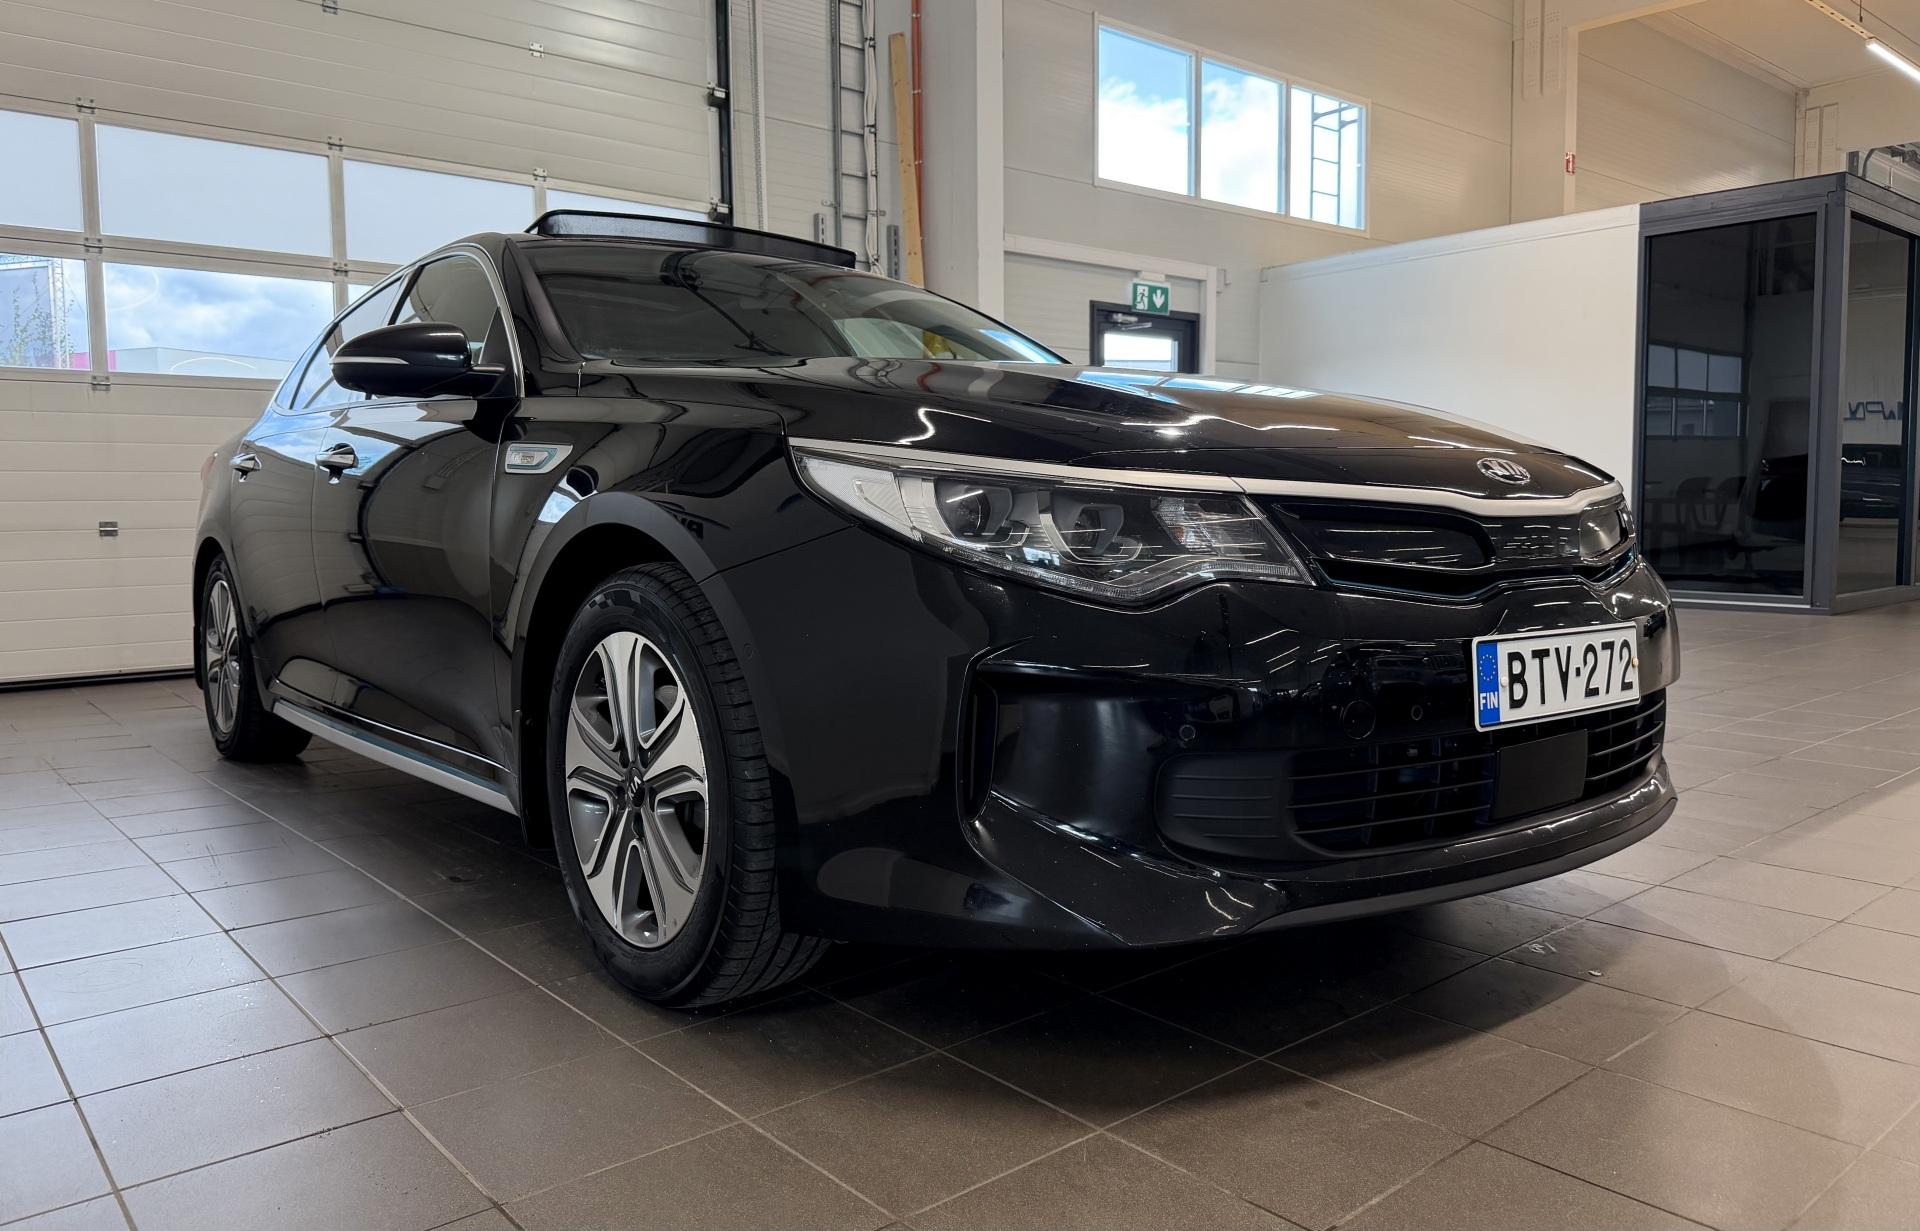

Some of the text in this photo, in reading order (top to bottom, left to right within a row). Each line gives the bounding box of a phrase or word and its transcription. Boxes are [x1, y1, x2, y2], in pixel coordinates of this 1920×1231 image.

[1480, 458, 1527, 479] KIA
[1507, 638, 1634, 709] BTV-272
[1479, 691, 1499, 711] FIN
[626, 775, 642, 801] KIA
